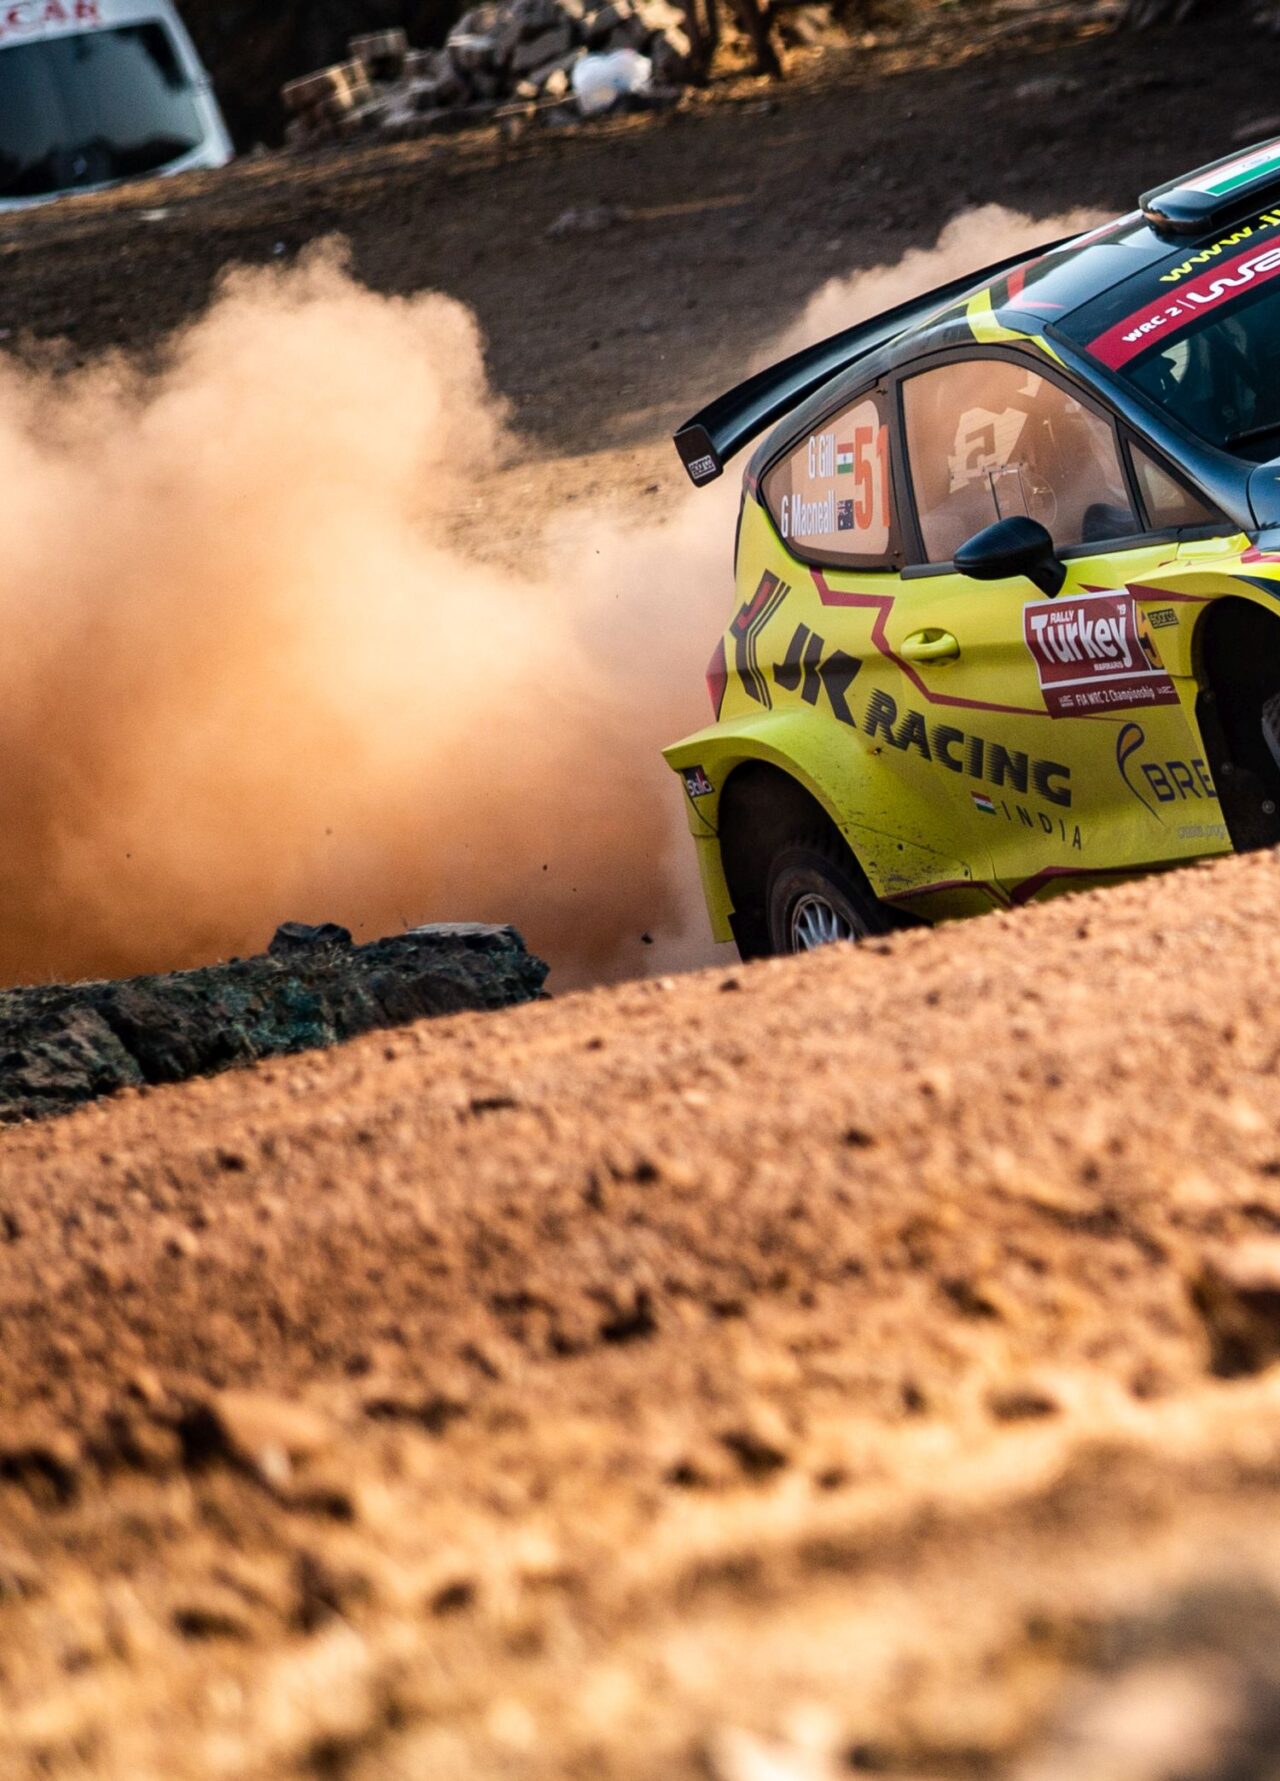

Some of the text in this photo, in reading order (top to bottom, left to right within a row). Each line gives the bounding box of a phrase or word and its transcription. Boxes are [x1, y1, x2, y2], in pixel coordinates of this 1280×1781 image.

[0, 0, 100, 34] CAR
[1122, 315, 1167, 343] WRC
[1165, 306, 1183, 318] 2
[808, 432, 836, 479] G Gill
[854, 424, 891, 530] 51
[780, 494, 789, 539] G
[1031, 608, 1133, 668] Turkey
[1050, 609, 1075, 623] RALLY
[773, 622, 1072, 808] JK RACING
[1004, 805, 1083, 851] INDIA
